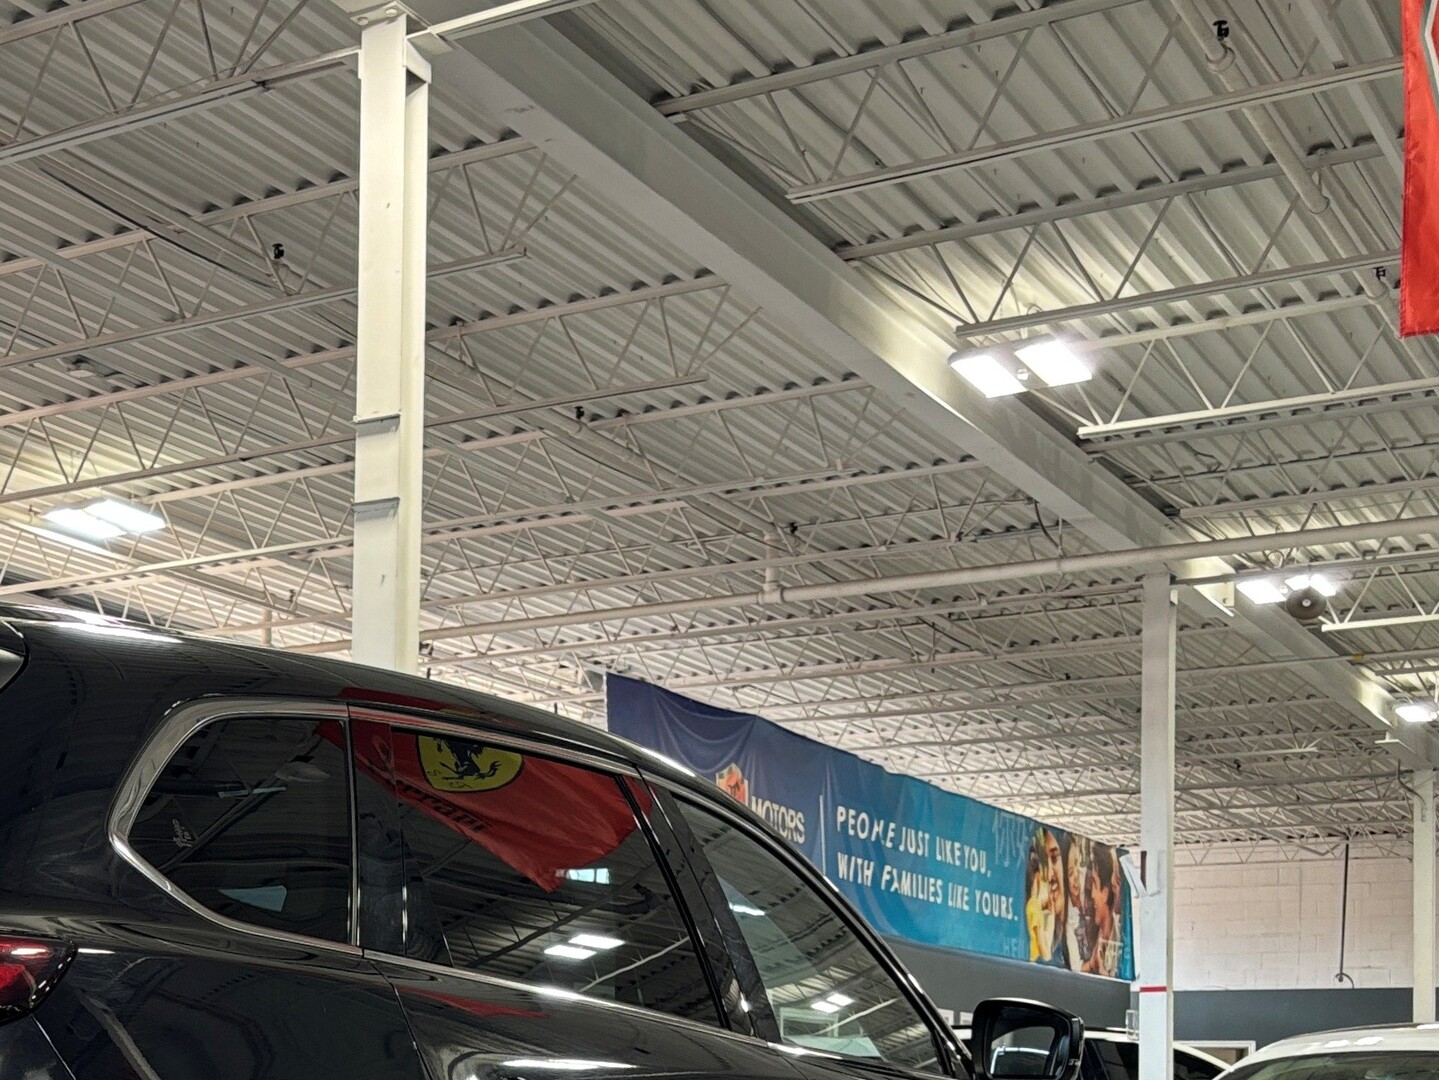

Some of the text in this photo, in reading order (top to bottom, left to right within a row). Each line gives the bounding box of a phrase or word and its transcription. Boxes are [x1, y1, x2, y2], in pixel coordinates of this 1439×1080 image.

[751, 795, 806, 844] MOTORS
[899, 826, 930, 858] JUST
[935, 836, 961, 867] LIKE
[837, 852, 1019, 922] WITH FAMILIES LIKE YOURS.
